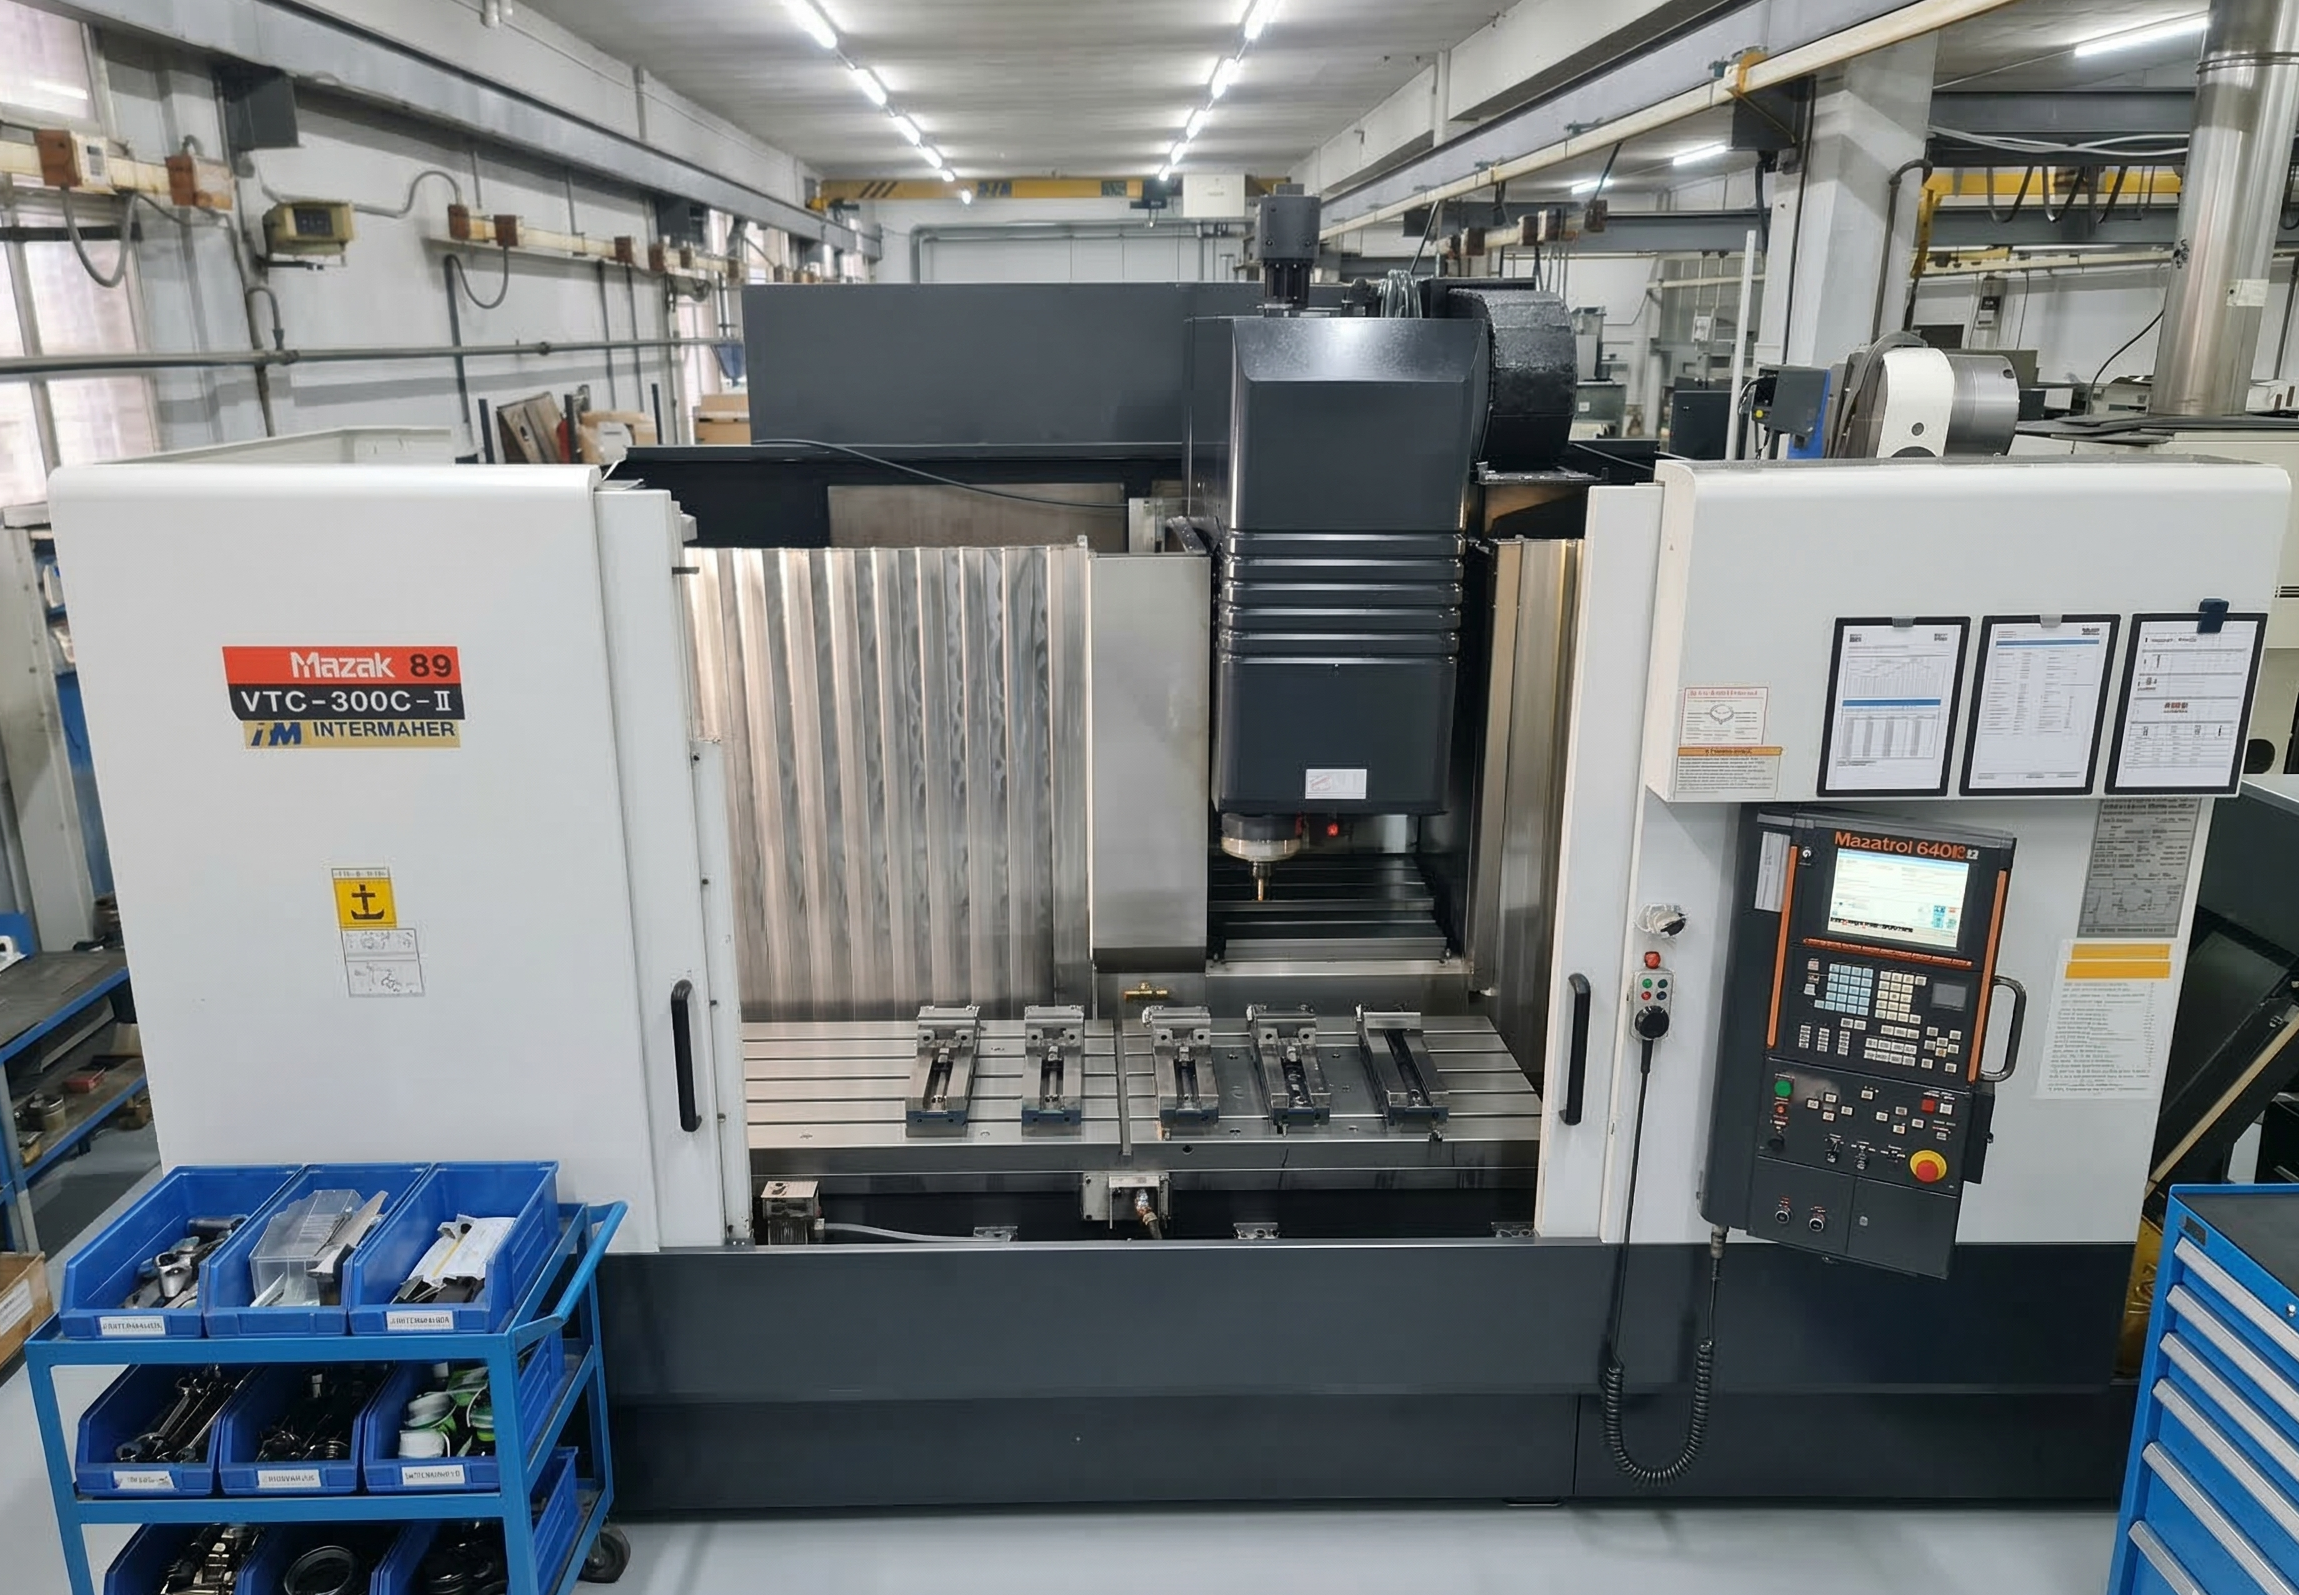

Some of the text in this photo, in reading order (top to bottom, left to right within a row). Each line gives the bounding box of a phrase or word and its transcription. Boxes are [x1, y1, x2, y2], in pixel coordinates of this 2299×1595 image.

[290, 652, 452, 678] Mazak 89
[314, 721, 455, 737] INTERMAHER
